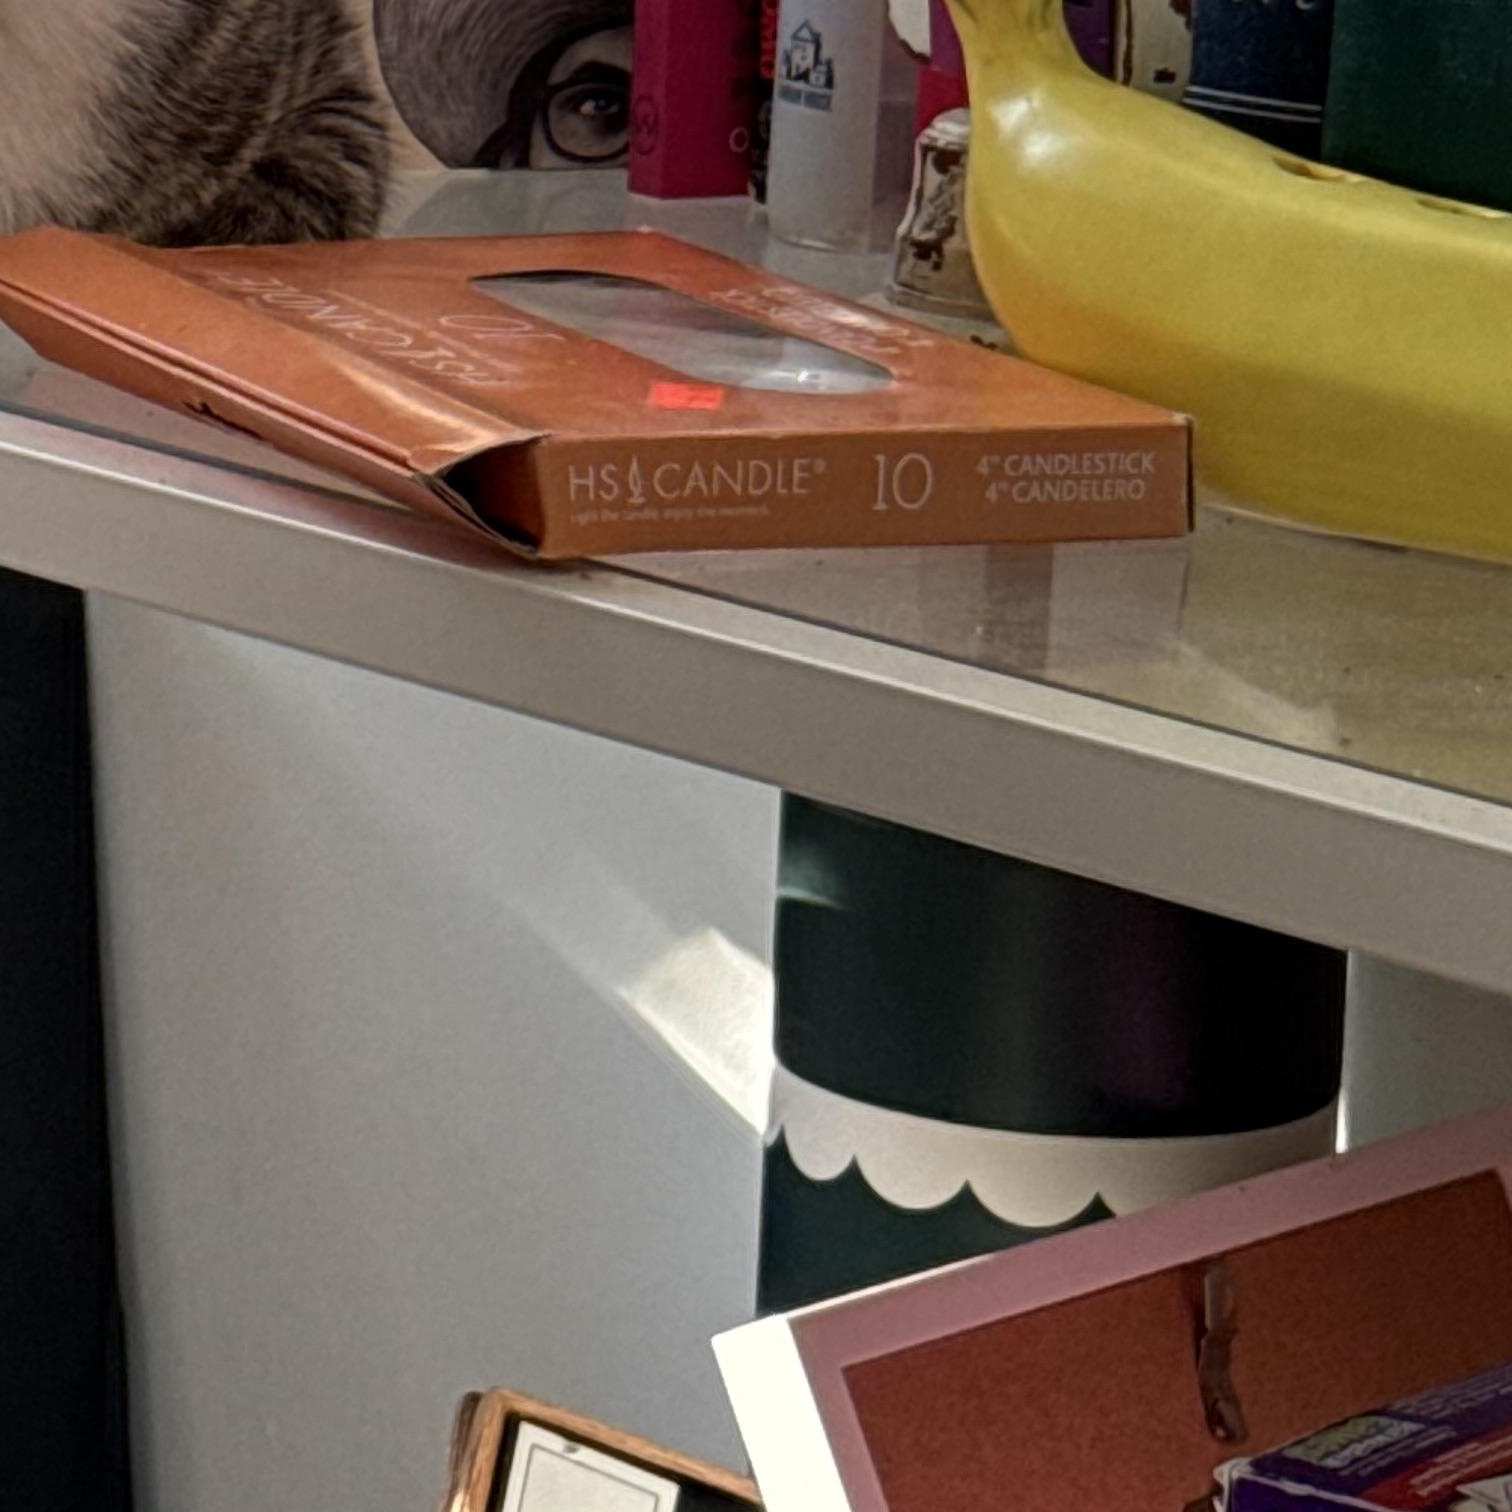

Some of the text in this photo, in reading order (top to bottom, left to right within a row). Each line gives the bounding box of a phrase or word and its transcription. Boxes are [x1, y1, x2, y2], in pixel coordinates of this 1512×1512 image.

[1003, 451, 1157, 476] CANDLESTICK
[567, 462, 620, 502] HS
[871, 452, 934, 511] 10
[1011, 479, 1146, 504] CANDELERO
